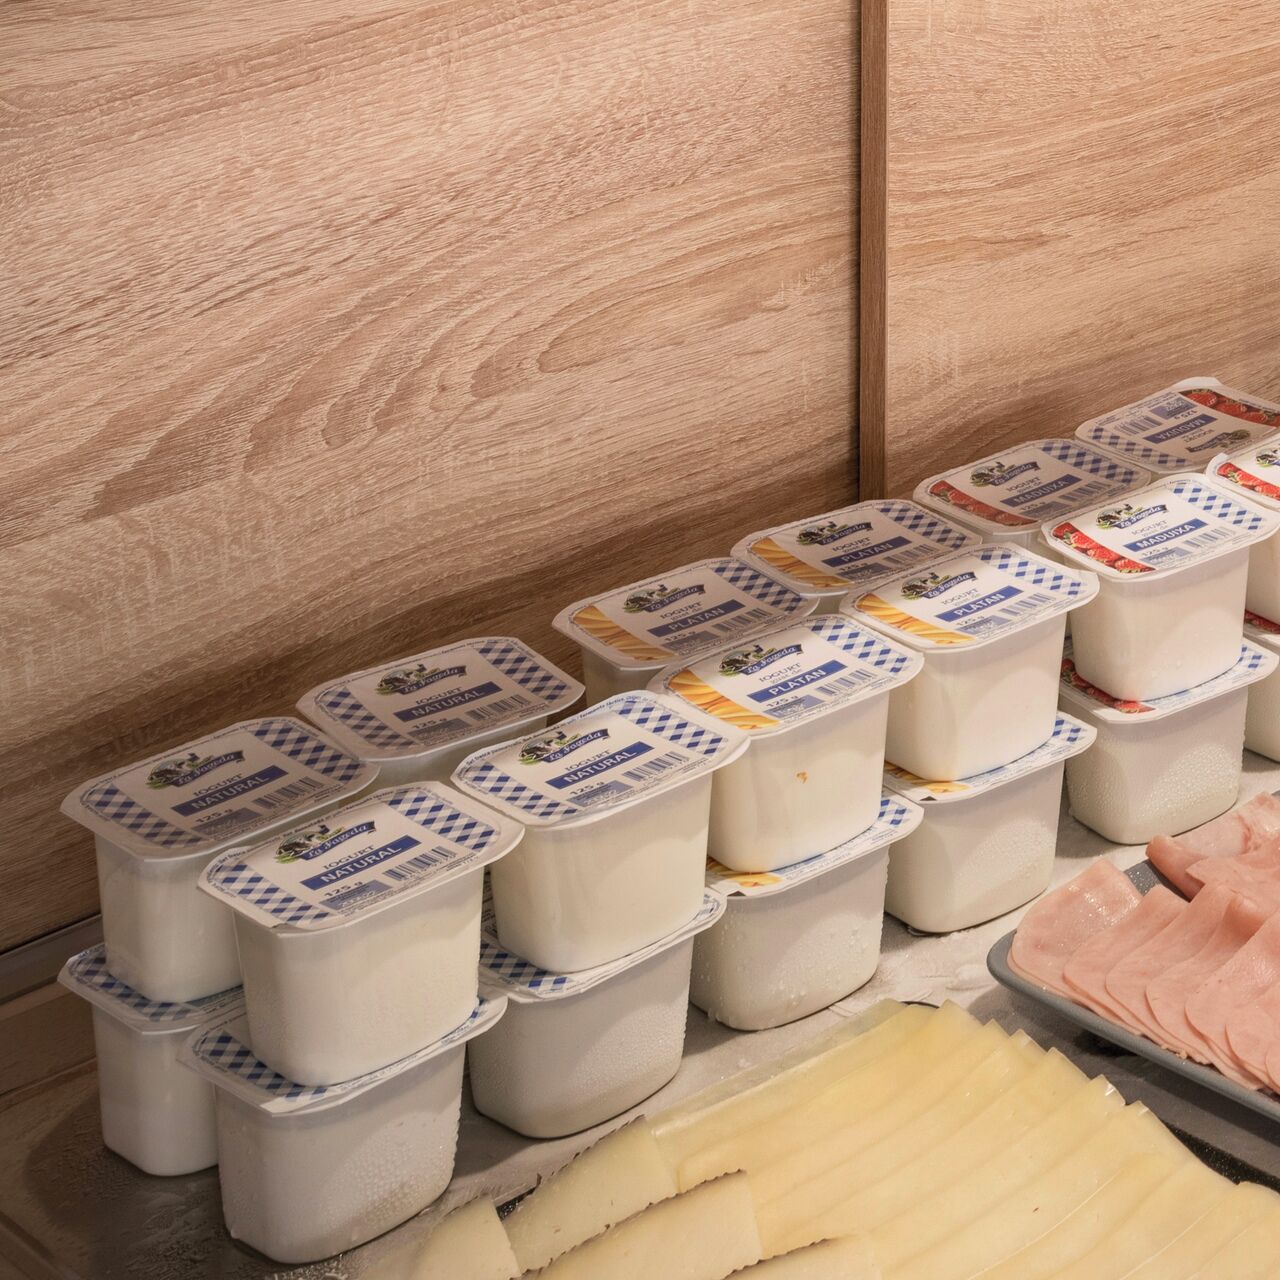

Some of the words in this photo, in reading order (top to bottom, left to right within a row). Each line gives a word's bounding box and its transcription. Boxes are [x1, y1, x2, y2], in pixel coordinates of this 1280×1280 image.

[1155, 420, 1206, 439] MADUIXA
[1013, 481, 1069, 504] MADUIXA
[832, 538, 871, 552] IOGURT
[1136, 525, 1195, 548] MADUIXA
[660, 603, 701, 619] IOGURT
[665, 634, 686, 642] 125
[759, 664, 801, 682] IOGURT
[412, 691, 484, 716] NATURAL
[416, 688, 462, 704] IOGURT
[767, 699, 788, 707] 125
[413, 720, 436, 729] 125
[550, 752, 562, 761] La
[564, 732, 601, 753] Fageda
[564, 753, 636, 782] NATURAL
[566, 750, 610, 771] IOGURT
[192, 776, 268, 808] NATURAL
[194, 775, 242, 796] IOGURT
[570, 784, 594, 795] 125
[196, 812, 221, 823] 125
[308, 849, 322, 858] La
[323, 825, 367, 848] Fageda
[321, 847, 402, 882] NATURAL
[323, 846, 374, 869] IOGURT
[325, 886, 350, 896] 125
